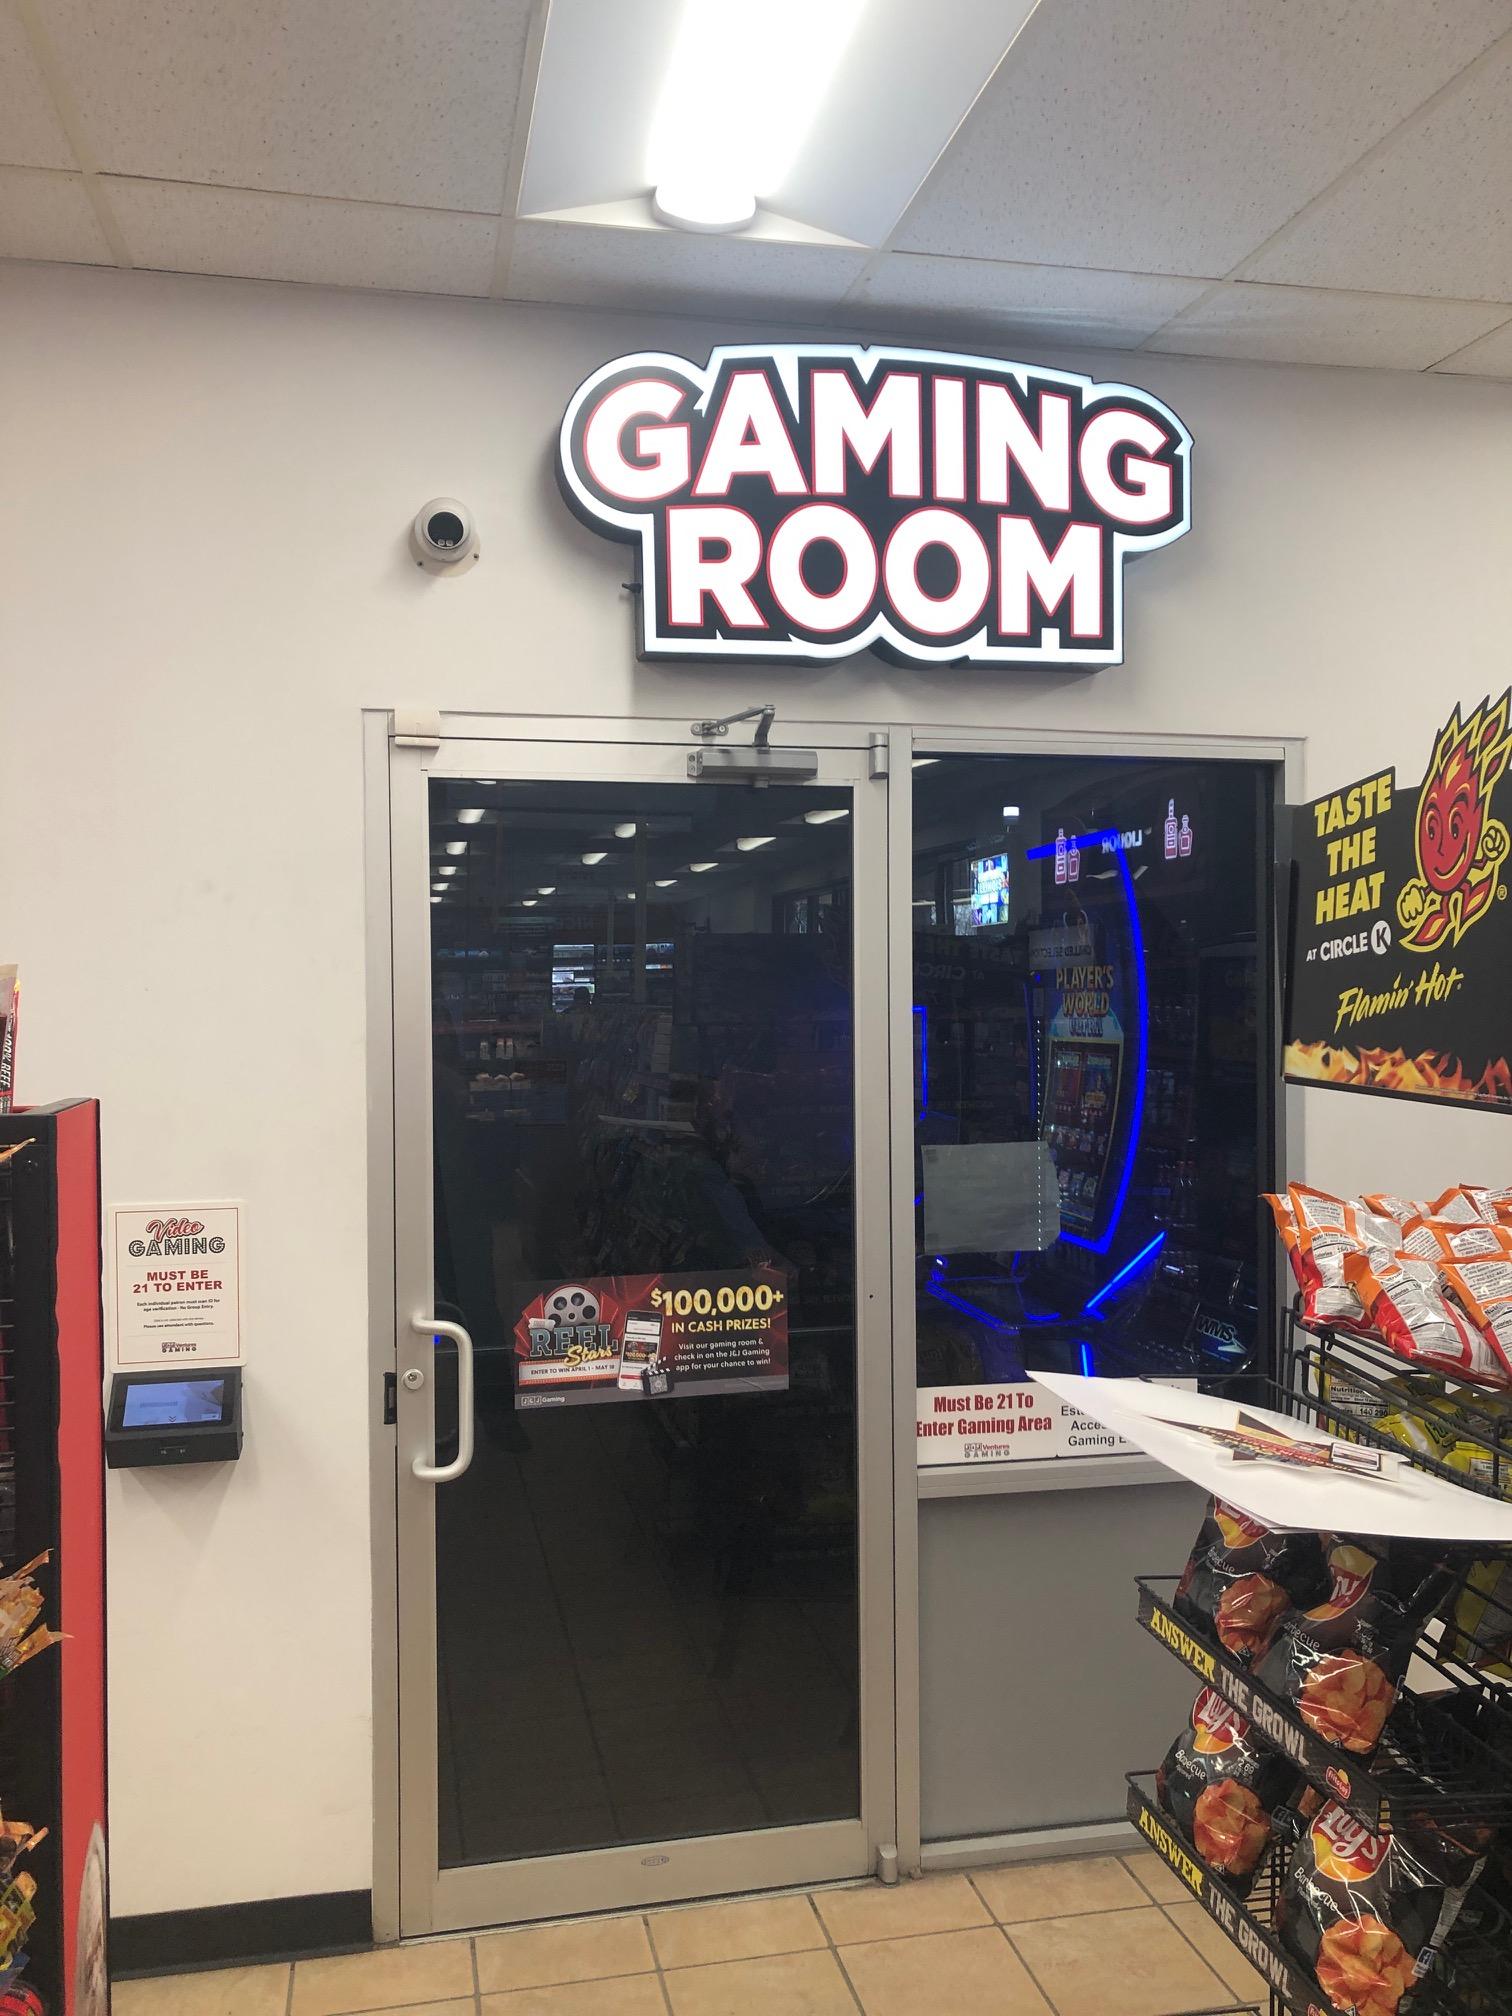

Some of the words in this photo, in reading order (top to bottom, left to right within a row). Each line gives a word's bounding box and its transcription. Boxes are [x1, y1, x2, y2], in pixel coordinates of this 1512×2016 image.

[582, 368, 1174, 525] GAMING
[665, 501, 1103, 638] ROOM
[1314, 773, 1392, 838] TASTE
[1327, 826, 1377, 876] THE
[1315, 871, 1385, 925] HEAT
[1306, 948, 1317, 962] AT
[1319, 931, 1368, 961] CIRCLE
[1373, 921, 1391, 952] K
[1056, 966, 1114, 990] PLAYER'S
[1062, 991, 1110, 1017] WORLD
[1334, 971, 1414, 1034] Flamin'
[1415, 961, 1464, 1007] Hot
[146, 1218, 205, 1243] Video
[128, 1236, 226, 1257] GAMING
[133, 1283, 148, 1293] 21
[154, 1282, 172, 1293] TO
[177, 1280, 223, 1291] ENTER
[147, 1270, 186, 1281] MUST
[190, 1269, 209, 1280] BE
[650, 1284, 784, 1316] $100,000+
[671, 1322, 684, 1333] IN
[688, 1320, 722, 1332] CASH
[726, 1317, 771, 1330] PRIZES!
[1197, 1314, 1236, 1344] WMS
[530, 1324, 618, 1357] REEL
[678, 1341, 694, 1350] Visit
[710, 1339, 736, 1350] gaming
[563, 1344, 613, 1367] Stars
[674, 1350, 695, 1361] check
[696, 1351, 703, 1359] in
[716, 1349, 728, 1358] the
[742, 1347, 770, 1357] Gaming
[675, 1364, 690, 1372] app
[691, 1361, 701, 1370] for
[703, 1361, 719, 1371] your
[720, 1359, 746, 1368] chance
[933, 1396, 971, 1413] Must
[974, 1394, 994, 1411] Be
[997, 1393, 1013, 1409] 21
[1016, 1392, 1034, 1409] To
[916, 1421, 954, 1437] Enter
[957, 1417, 1014, 1435] Gaming
[1018, 1415, 1052, 1432] Area
[982, 1443, 1010, 1451] Ventures
[1068, 1434, 1115, 1447] Gaming
[964, 1449, 1010, 1458] GAMING
[1283, 1620, 1321, 1651] arbecue
[1151, 1606, 1217, 1683] ANSWER
[1220, 1664, 1250, 1712] THE
[1252, 1694, 1310, 1767] GROWL
[1318, 1805, 1386, 1860] Lay's
[1139, 1806, 1205, 1896] ANSWER
[1208, 1882, 1237, 1933] THE
[1238, 1918, 1293, 1999] GROWL
